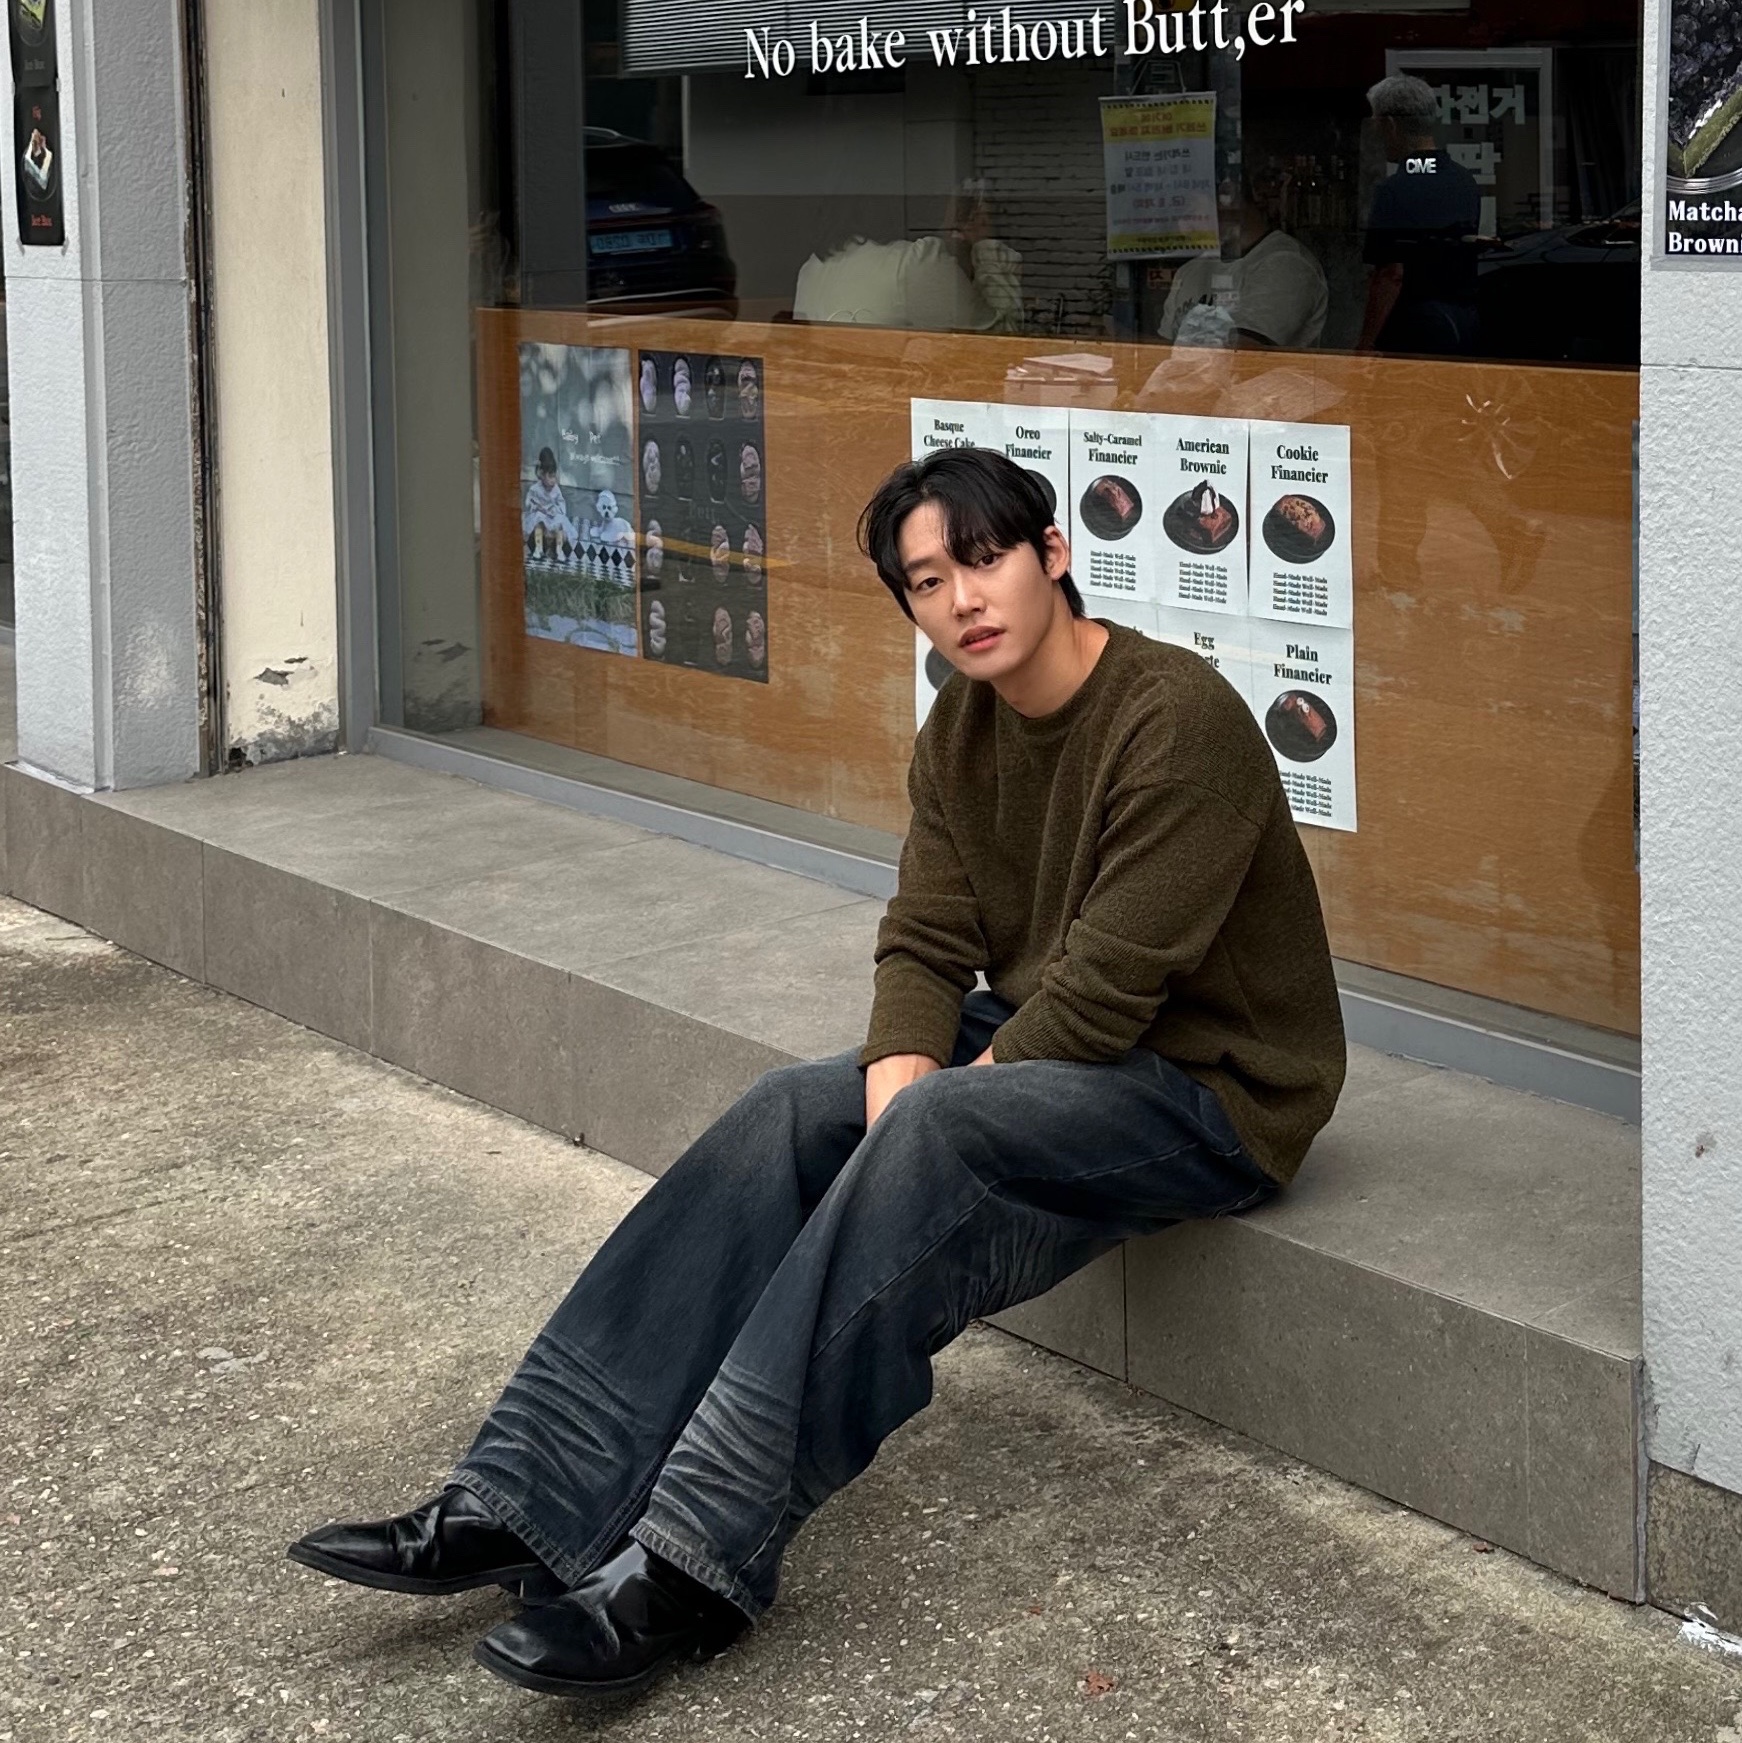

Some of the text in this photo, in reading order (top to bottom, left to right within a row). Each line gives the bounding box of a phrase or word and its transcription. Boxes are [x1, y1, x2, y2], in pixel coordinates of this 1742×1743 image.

[744, 27, 795, 79] No
[811, 17, 906, 74] bake
[927, 10, 1107, 67] without
[933, 418, 964, 434] Basque
[1015, 425, 1040, 441] Oreo
[923, 434, 953, 448] Cheese
[1083, 431, 1143, 447] Salty-Caramel
[1176, 438, 1230, 454] American
[1005, 443, 1052, 460] Financier
[1088, 448, 1138, 465] Financier
[1276, 444, 1319, 462] Cookie
[1180, 458, 1227, 475] Brownie
[1270, 464, 1329, 484] Financier
[1194, 632, 1215, 650] Egg
[1286, 644, 1318, 662] Plain
[1274, 663, 1332, 685] Financier
